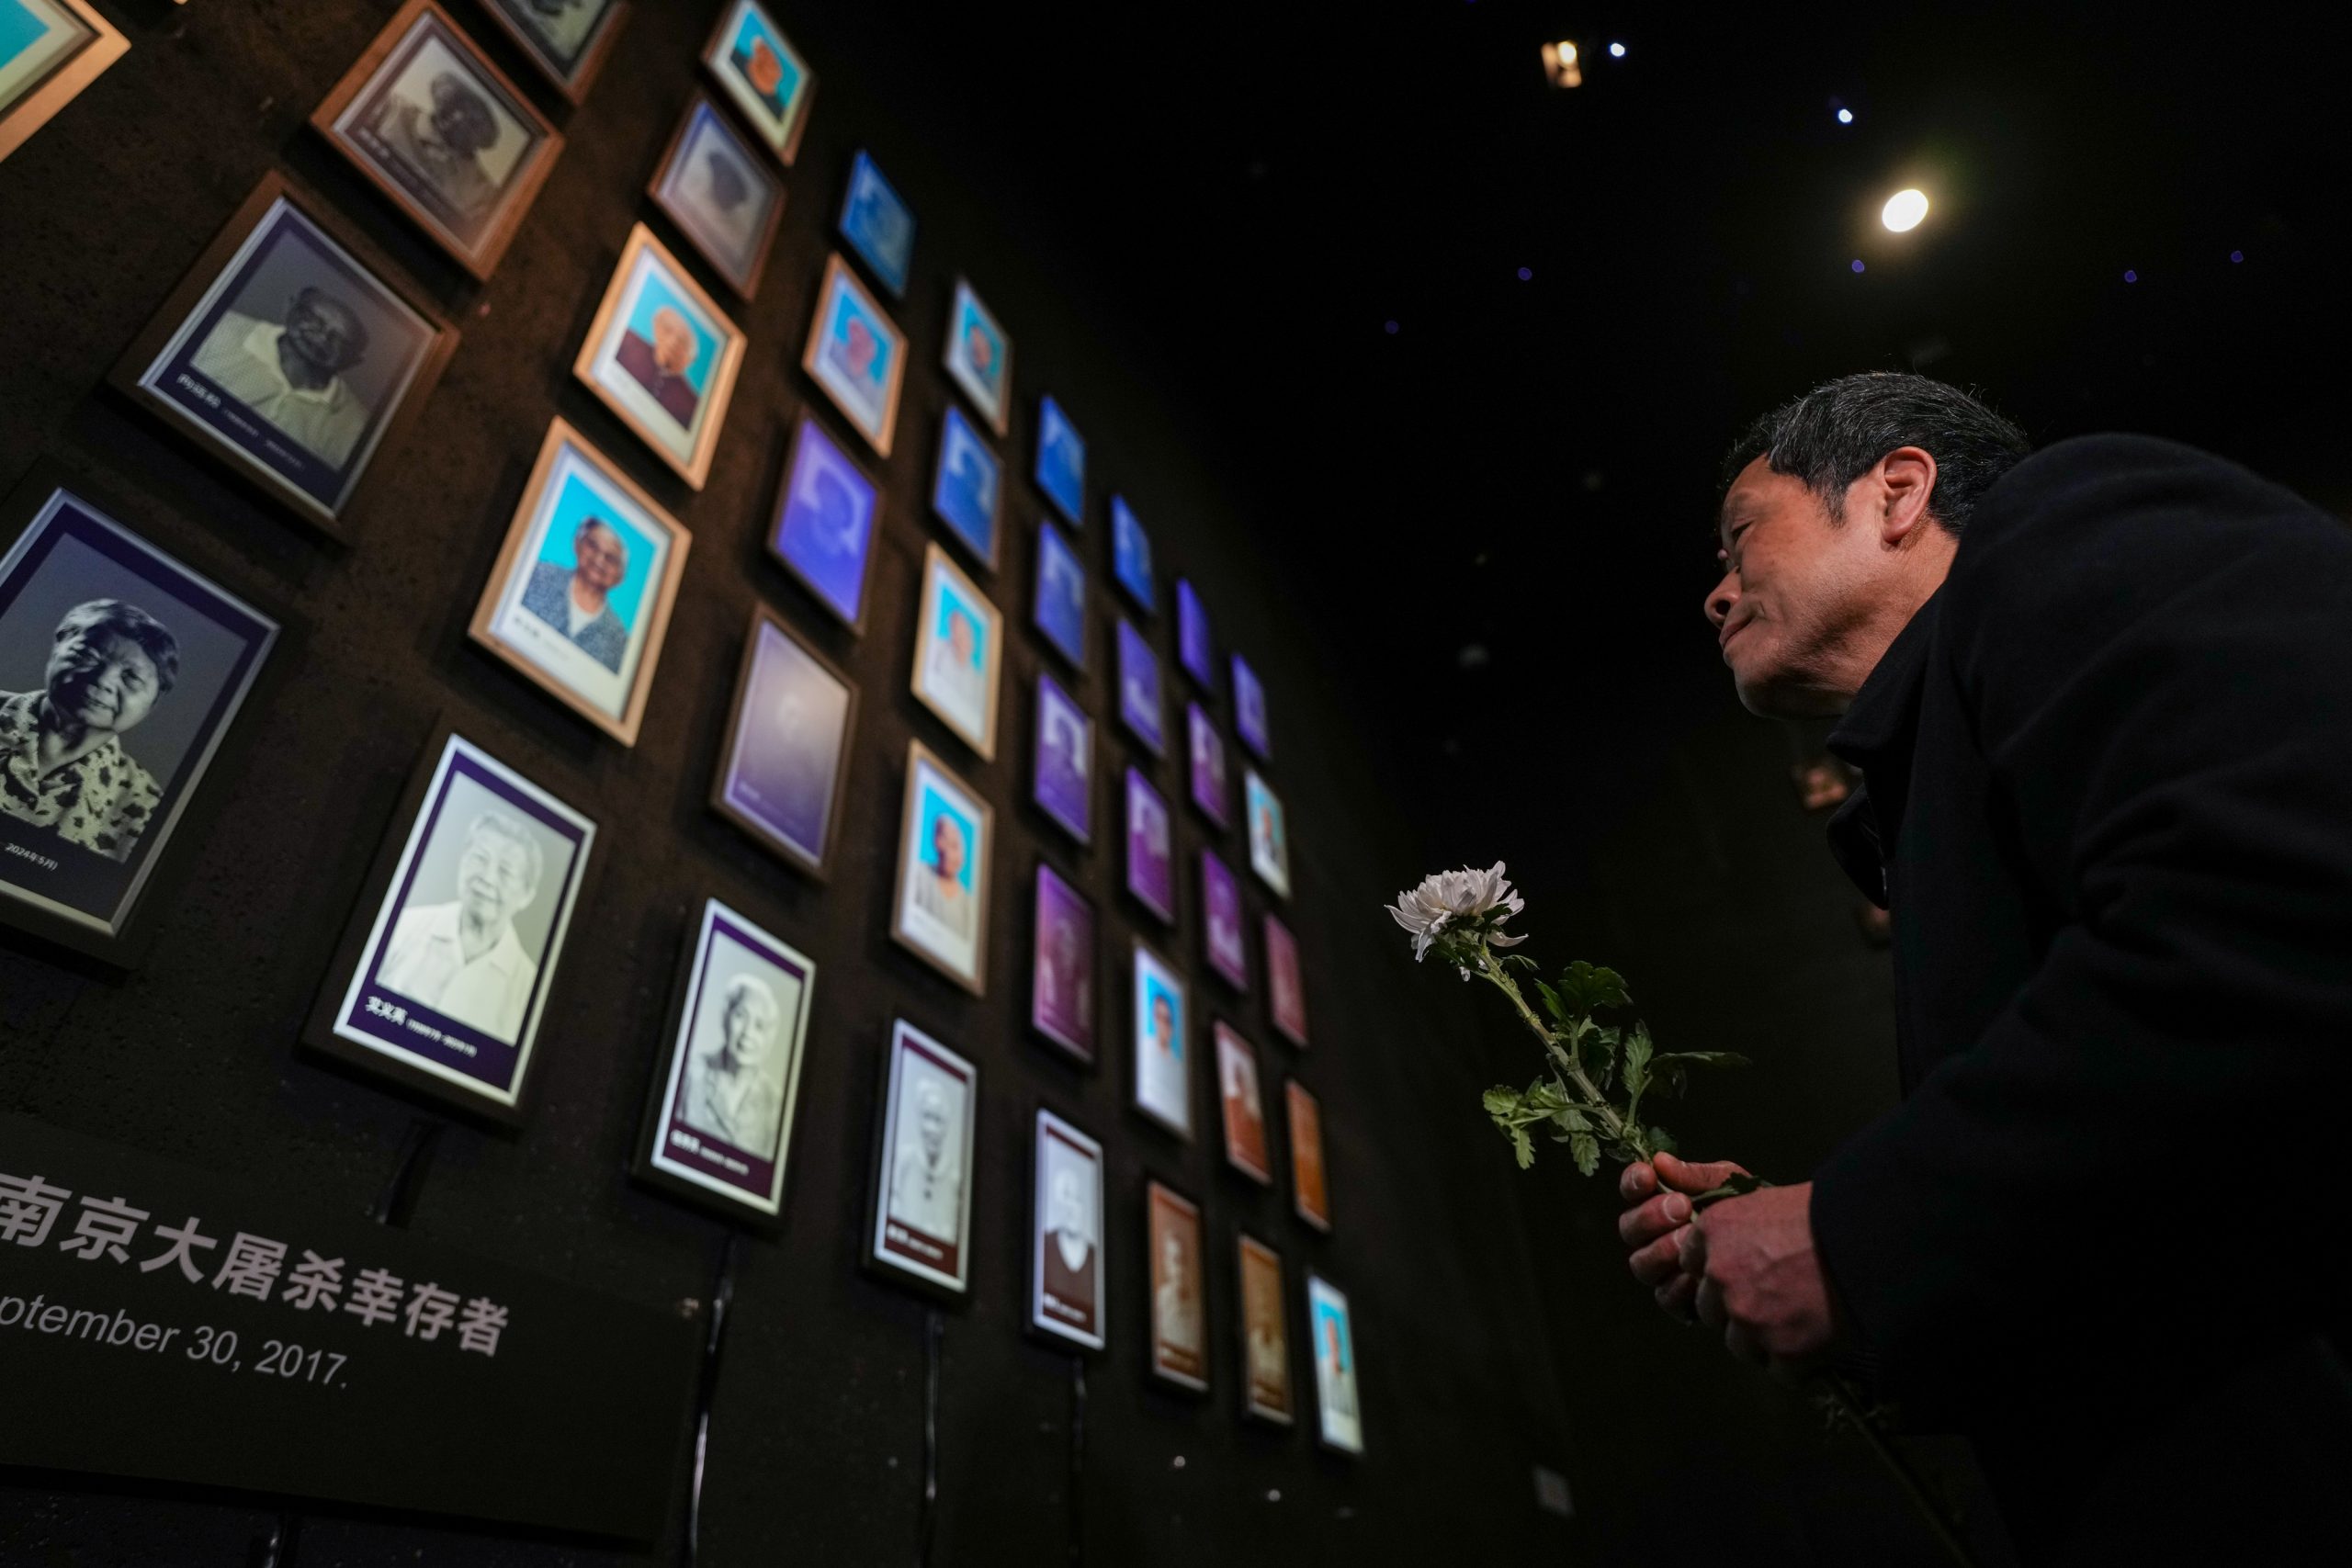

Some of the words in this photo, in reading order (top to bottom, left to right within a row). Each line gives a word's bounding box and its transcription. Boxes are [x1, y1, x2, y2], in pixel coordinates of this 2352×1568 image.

[0, 1173, 508, 1357] 南京大屠杀幸存者
[187, 1325, 241, 1372] 30,
[254, 1339, 348, 1389] 2017.
